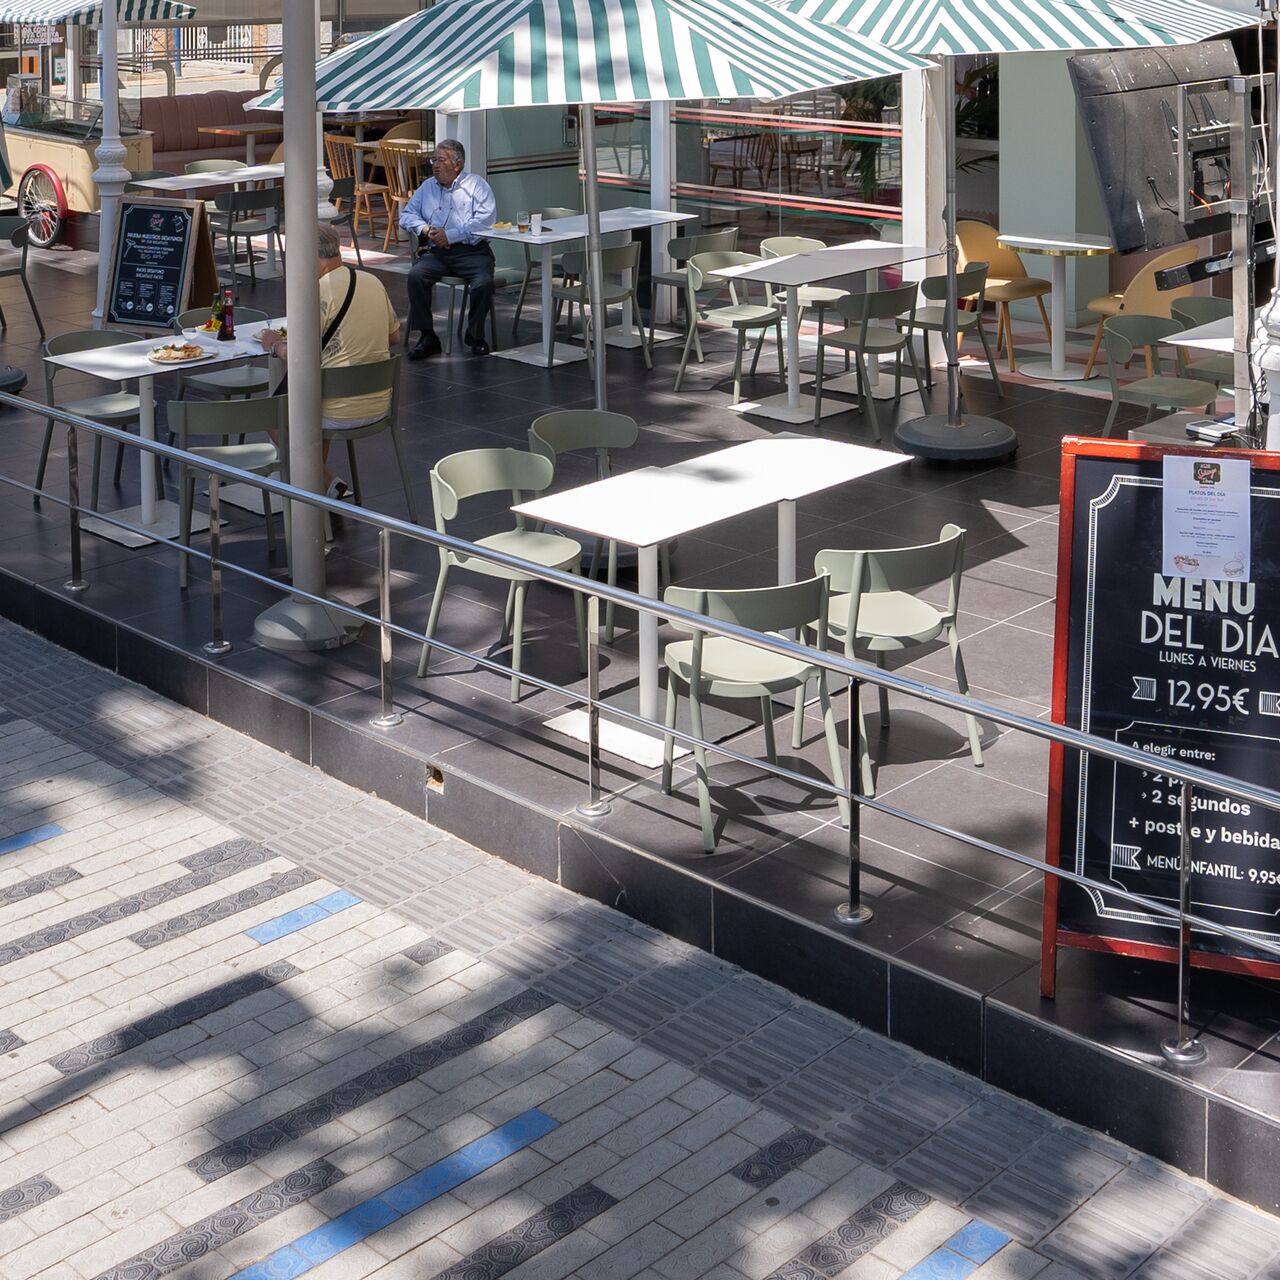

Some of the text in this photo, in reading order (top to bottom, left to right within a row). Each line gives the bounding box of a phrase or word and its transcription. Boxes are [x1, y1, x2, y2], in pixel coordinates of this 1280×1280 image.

[1140, 610, 1280, 659] DEL DÍA
[1159, 650, 1257, 673] LUNES A VIERNES
[1168, 678, 1250, 716] 12,95€
[1142, 742, 1177, 757] elegir
[1179, 748, 1216, 761] entre:
[1151, 789, 1163, 804] 2
[1144, 819, 1201, 838] poste
[1204, 828, 1217, 843] y
[1189, 859, 1245, 880] NFANTIL:
